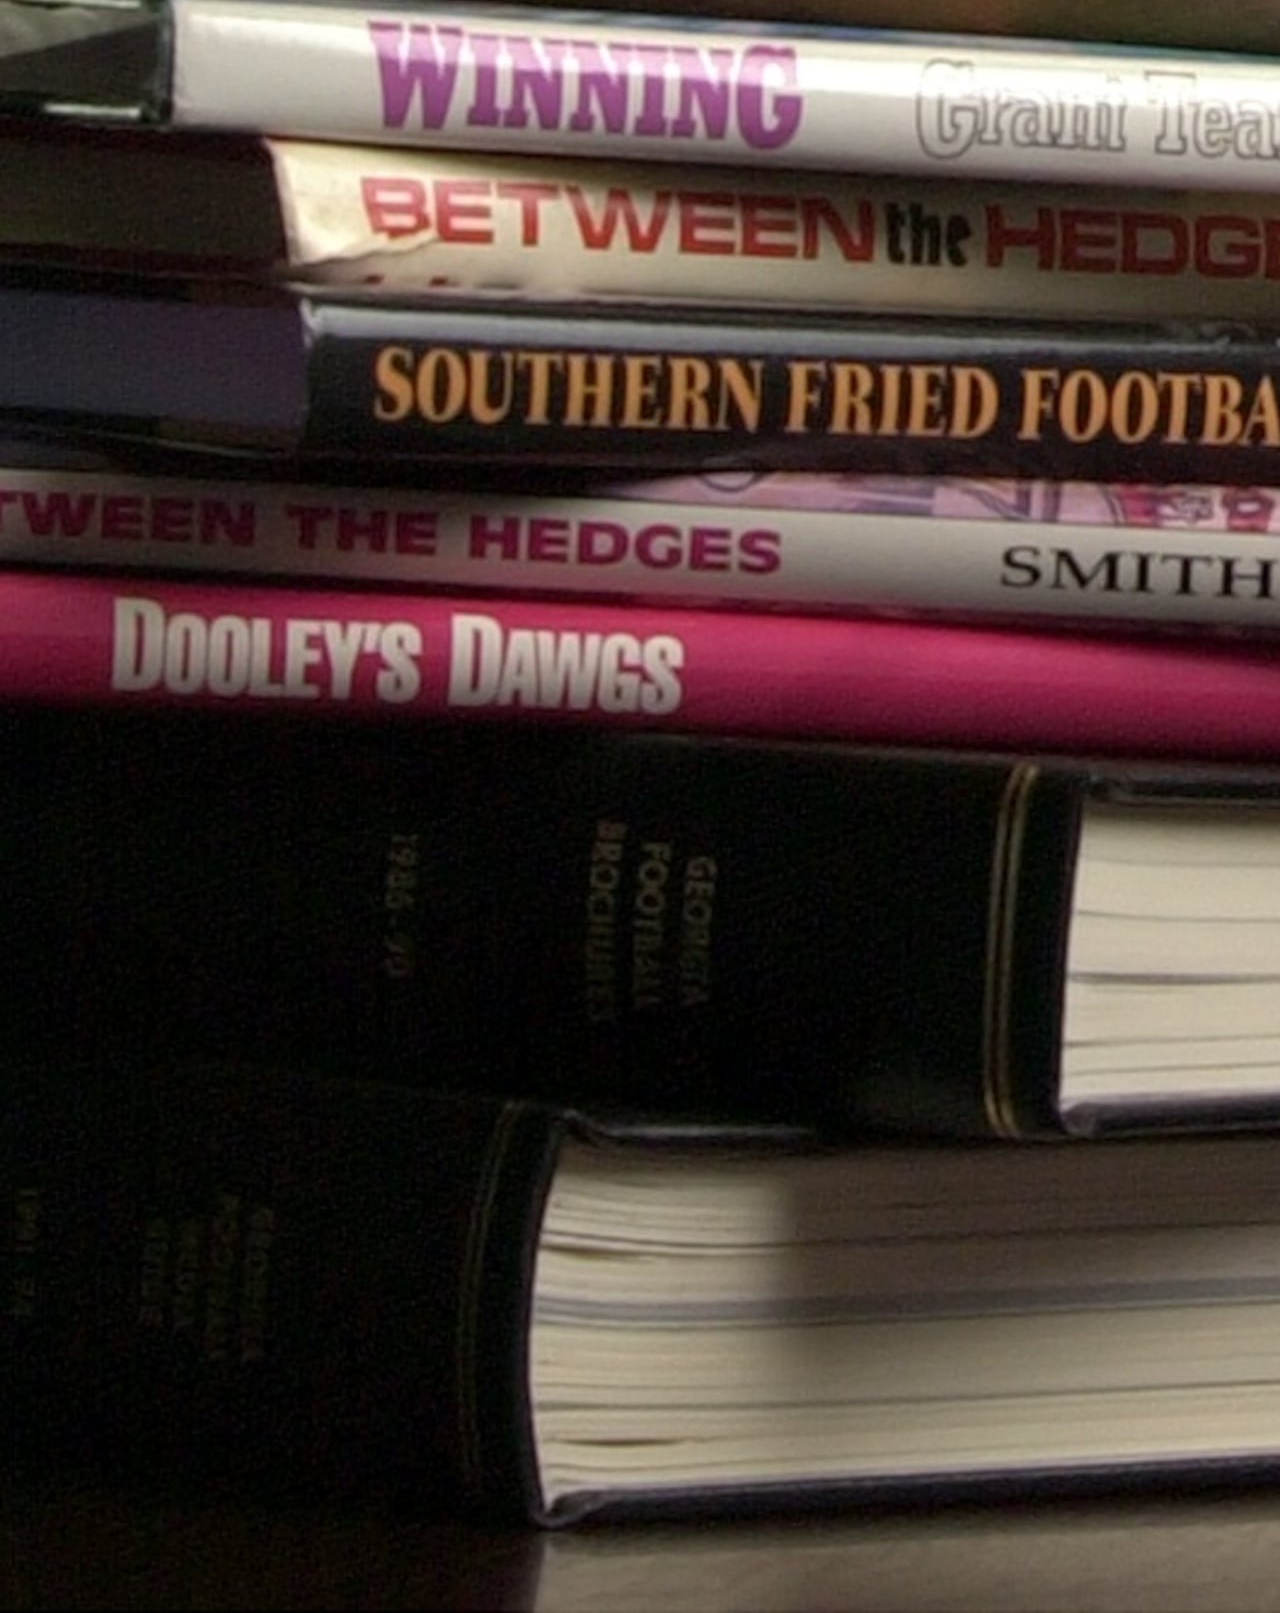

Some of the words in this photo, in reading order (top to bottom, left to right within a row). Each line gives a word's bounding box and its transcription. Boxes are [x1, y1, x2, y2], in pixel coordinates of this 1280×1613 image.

[367, 20, 803, 149] WINNING
[916, 57, 1127, 160] Grant
[360, 177, 875, 263] BETWEEN
[886, 203, 972, 268] the
[372, 345, 764, 433] SOUTHERN
[787, 359, 999, 439] FRIED
[288, 505, 438, 556] THE
[468, 515, 782, 574] HEDGES
[1000, 545, 1279, 600] SMITH
[111, 596, 424, 703] DOOLEY'S
[447, 612, 685, 714] DAWGS
